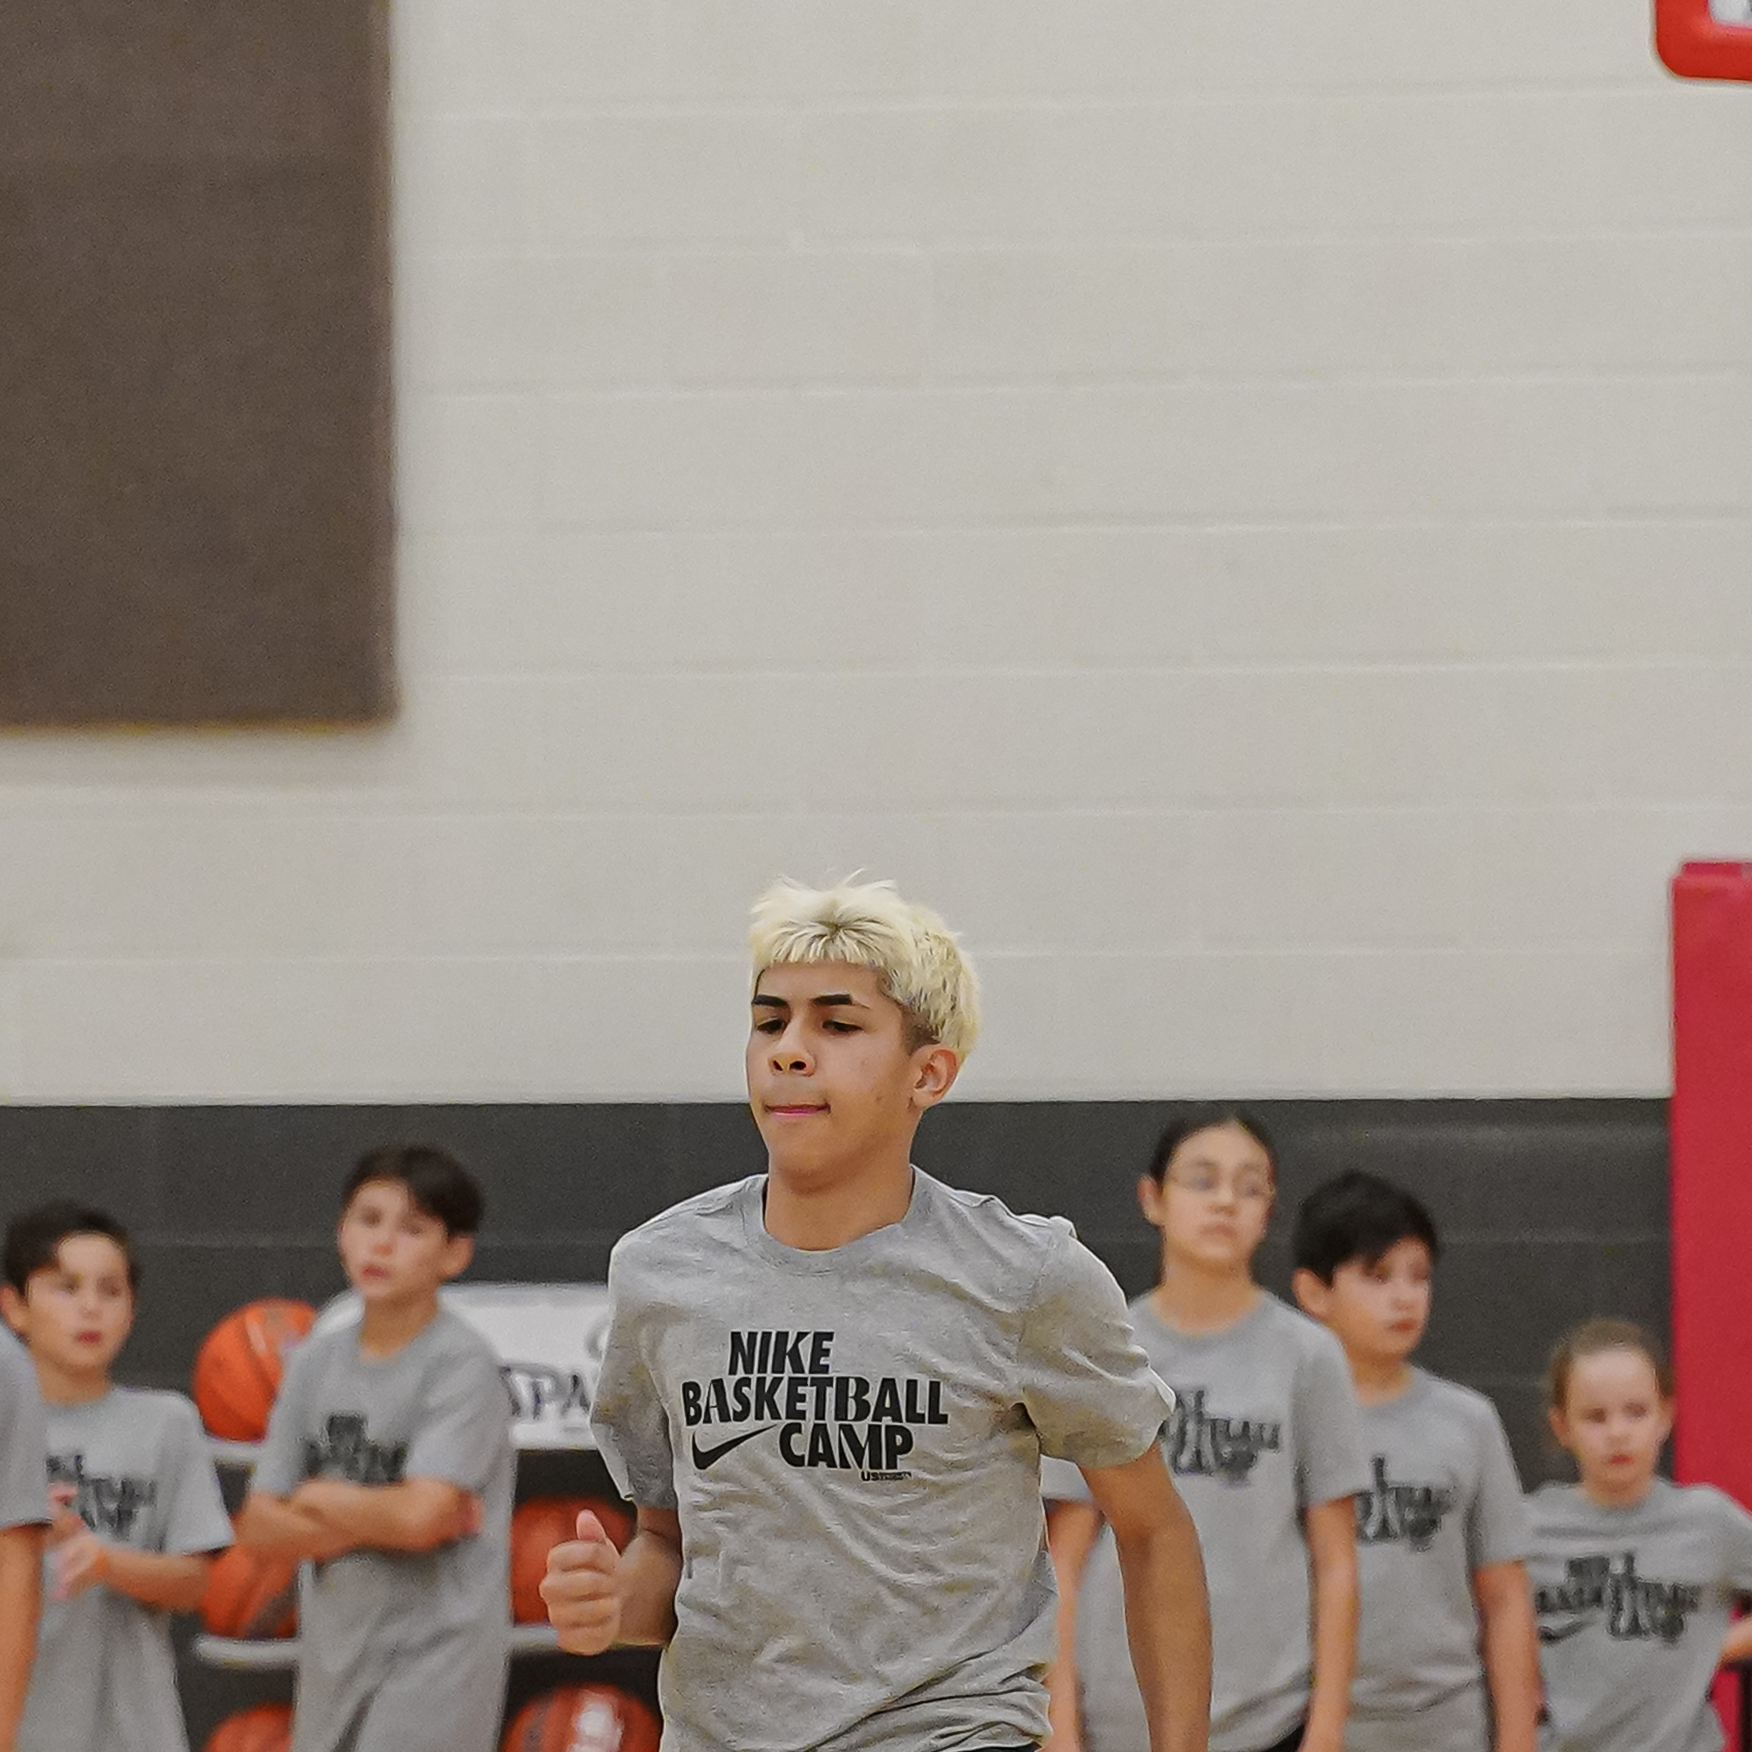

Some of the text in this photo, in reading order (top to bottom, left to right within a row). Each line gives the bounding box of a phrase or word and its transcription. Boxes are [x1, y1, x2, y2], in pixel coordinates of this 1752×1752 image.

[728, 1331, 835, 1375] NIKE
[682, 1376, 949, 1427] BASKETBALL
[779, 1424, 914, 1470] CAMP
